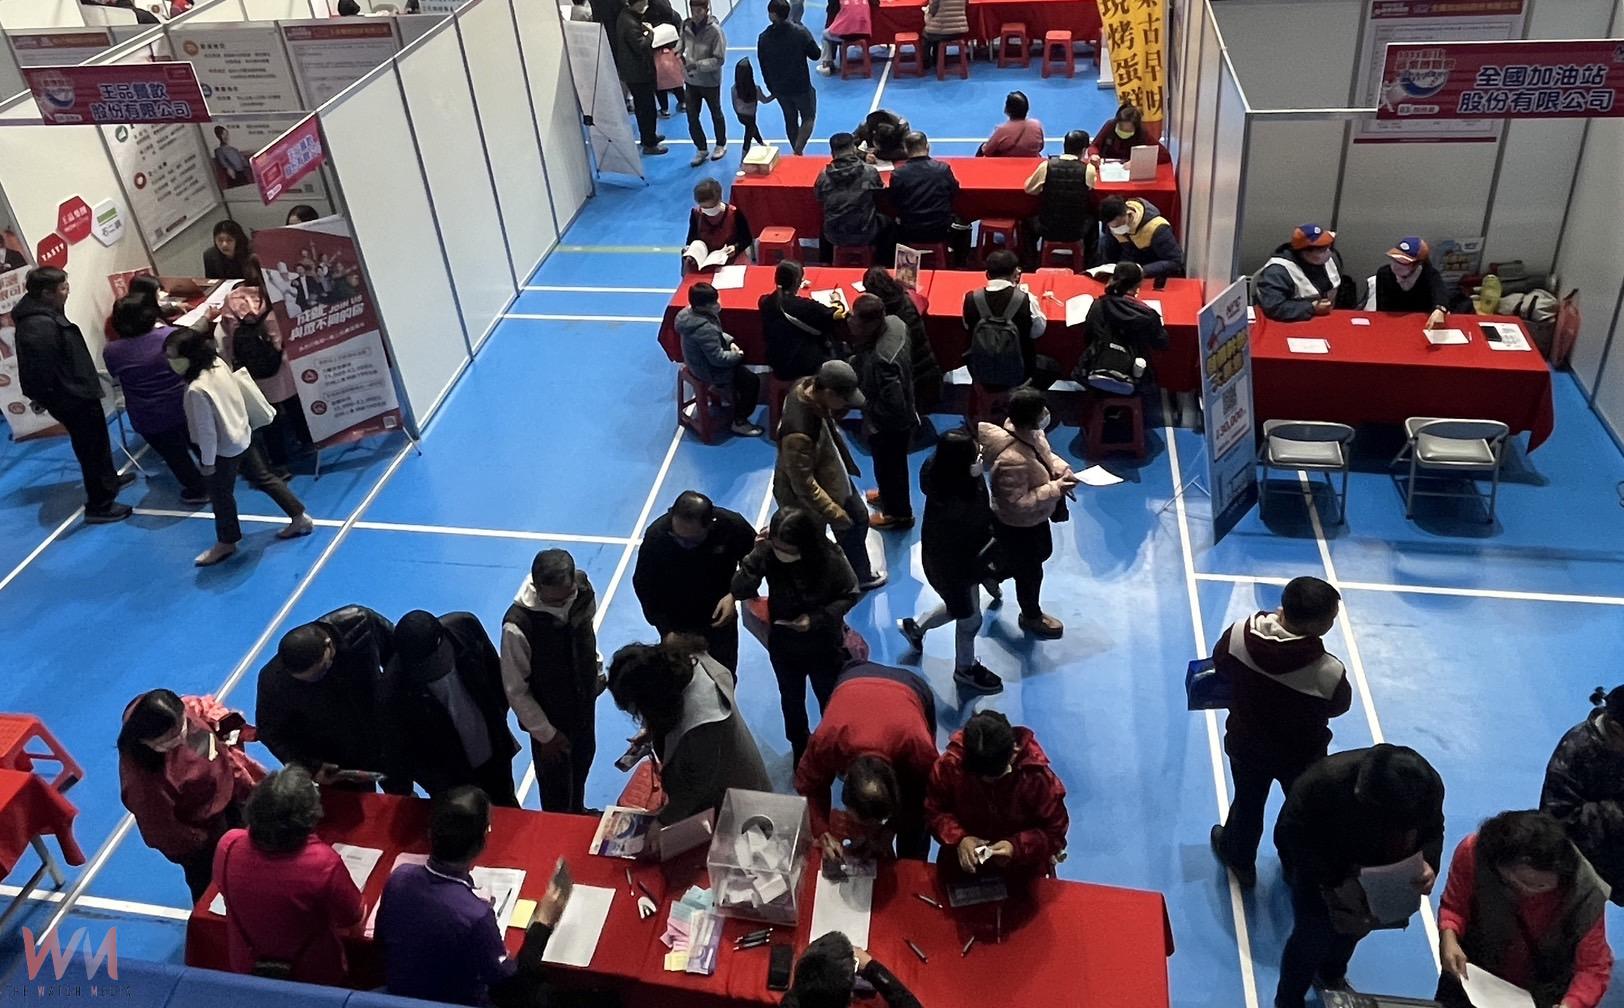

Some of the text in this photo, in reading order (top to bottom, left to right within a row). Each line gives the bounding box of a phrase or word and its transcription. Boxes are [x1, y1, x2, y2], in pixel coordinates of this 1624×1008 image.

[1475, 65, 1607, 89] 全國加油站
[98, 83, 168, 101] 王品餐飲
[1457, 89, 1614, 114] 股份有限公司
[90, 101, 192, 121] 股份有限公司
[41, 242, 65, 262] TASTY
